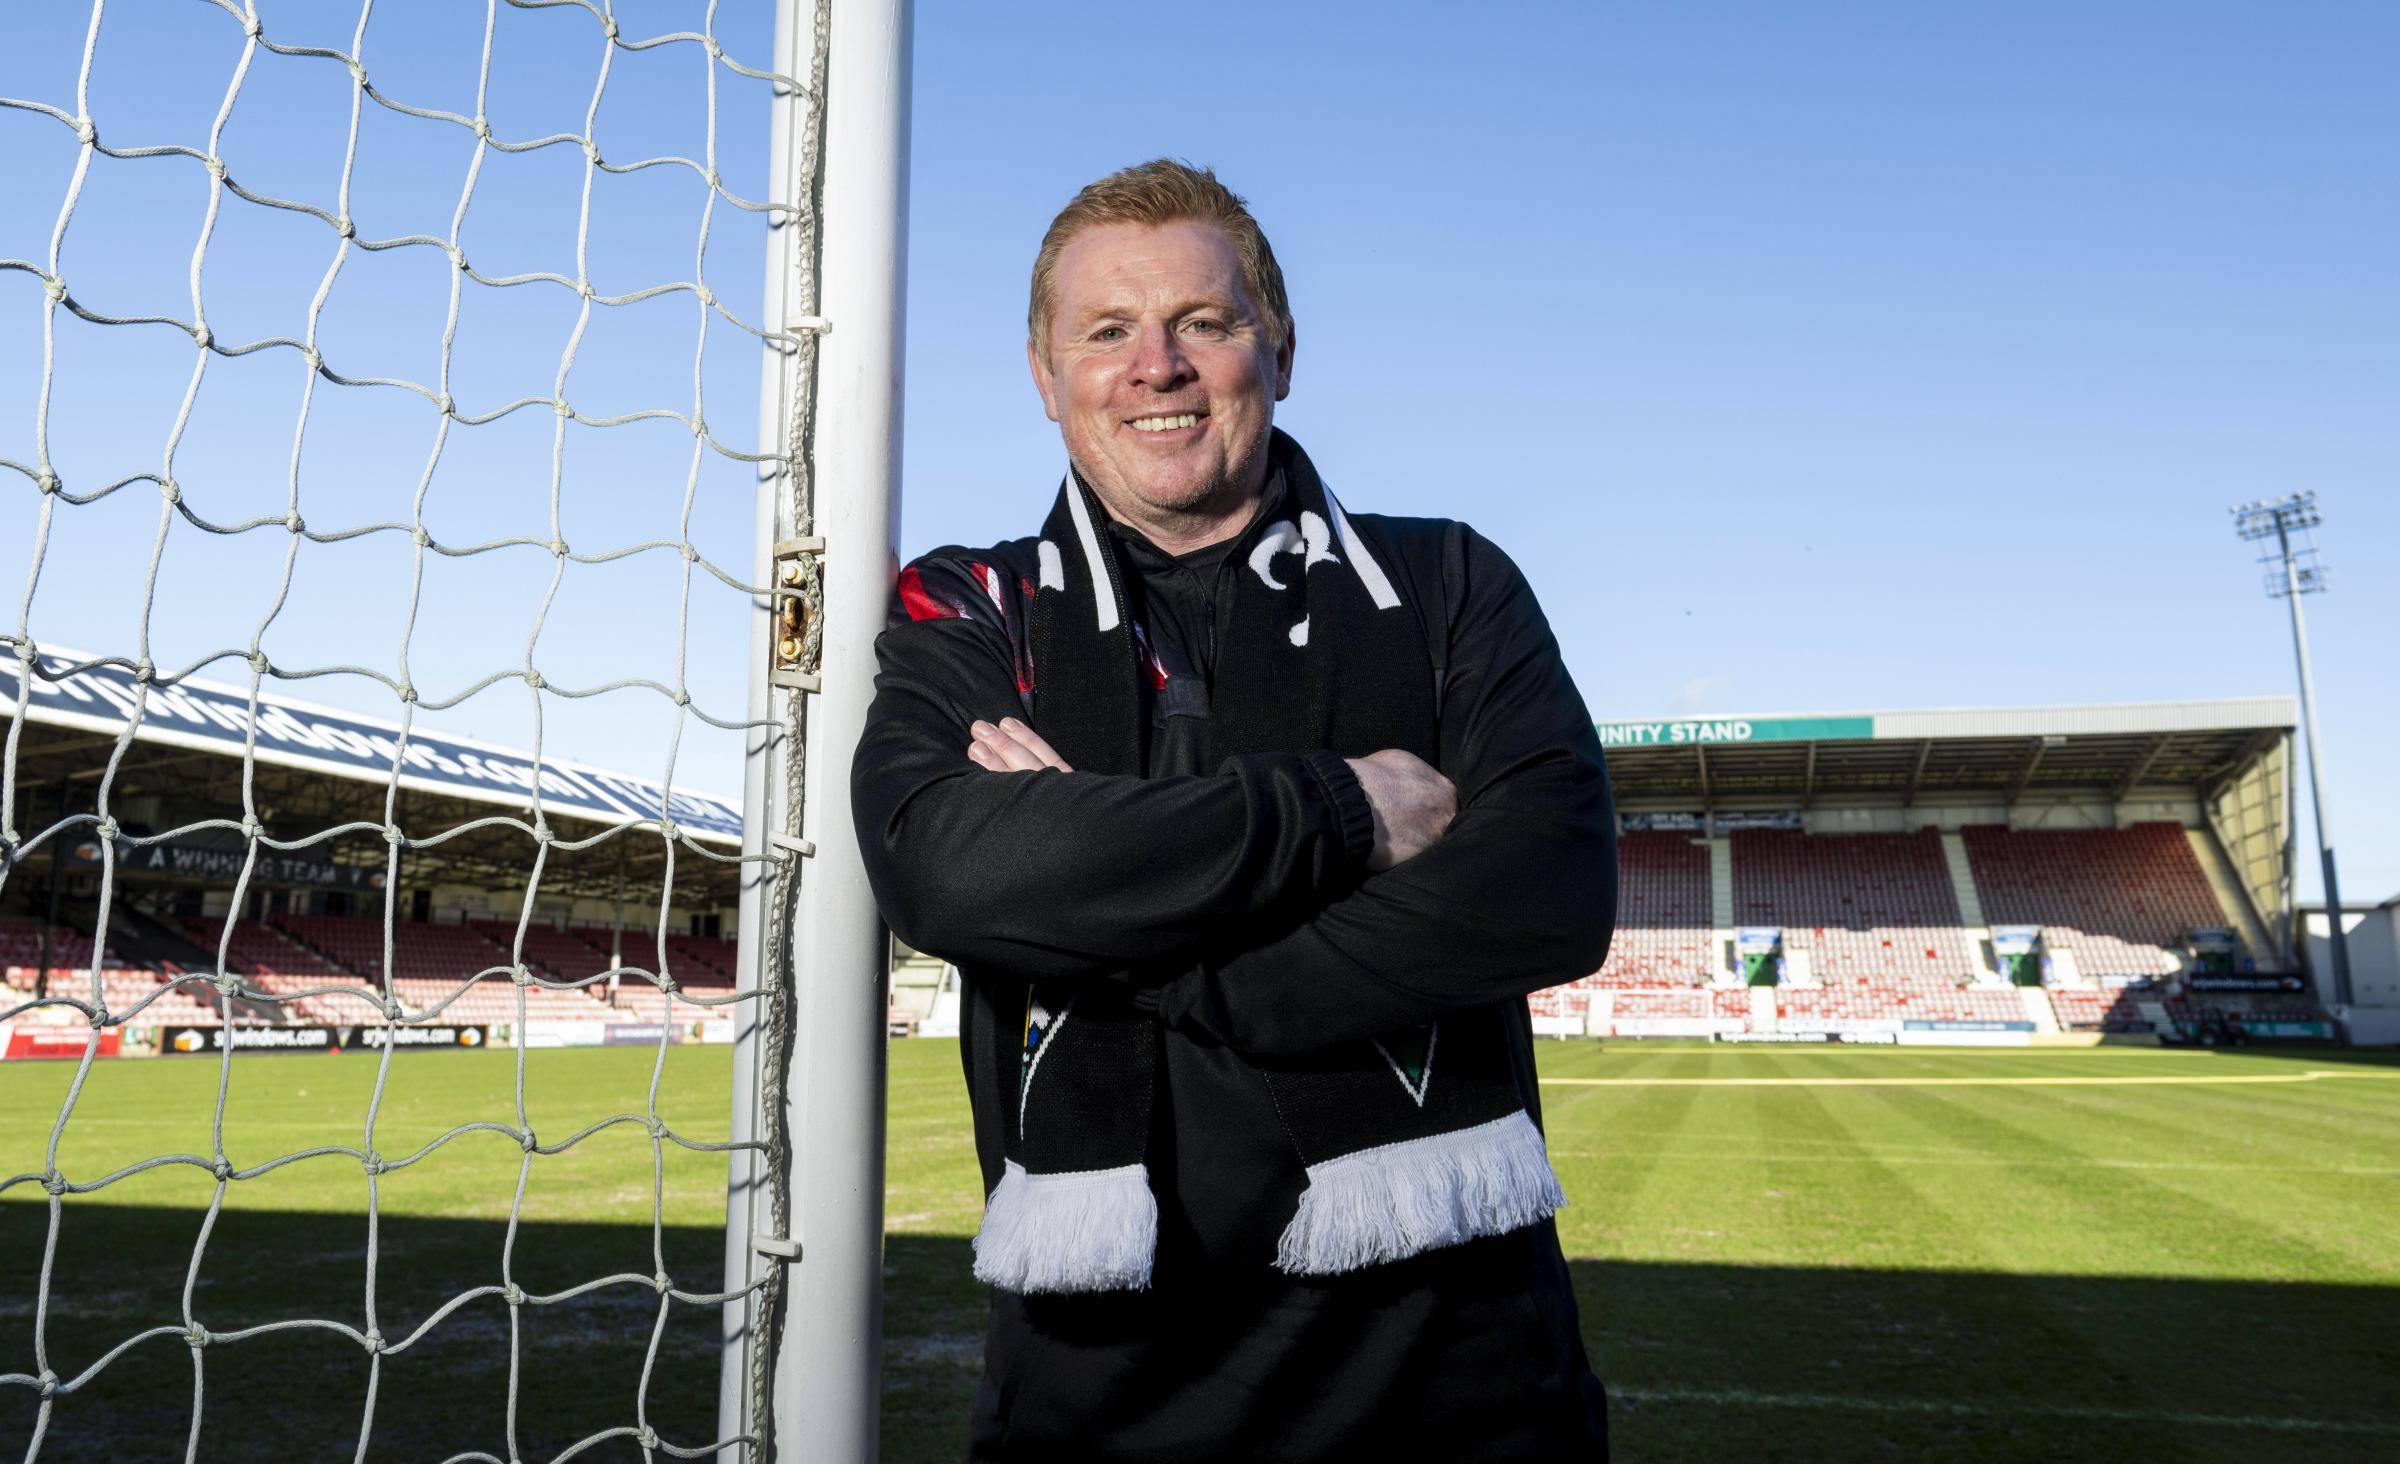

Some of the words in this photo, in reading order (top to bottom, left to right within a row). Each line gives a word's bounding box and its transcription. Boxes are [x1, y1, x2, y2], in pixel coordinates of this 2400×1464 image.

[2, 656, 590, 800] srjwindows.com
[1670, 720, 1753, 741] STAND
[149, 847, 166, 868] A
[172, 848, 273, 878] WINNIG
[280, 859, 337, 883] TEAM
[214, 1027, 328, 1049] sjwindows.com
[362, 1026, 455, 1048] srjwndows.com
